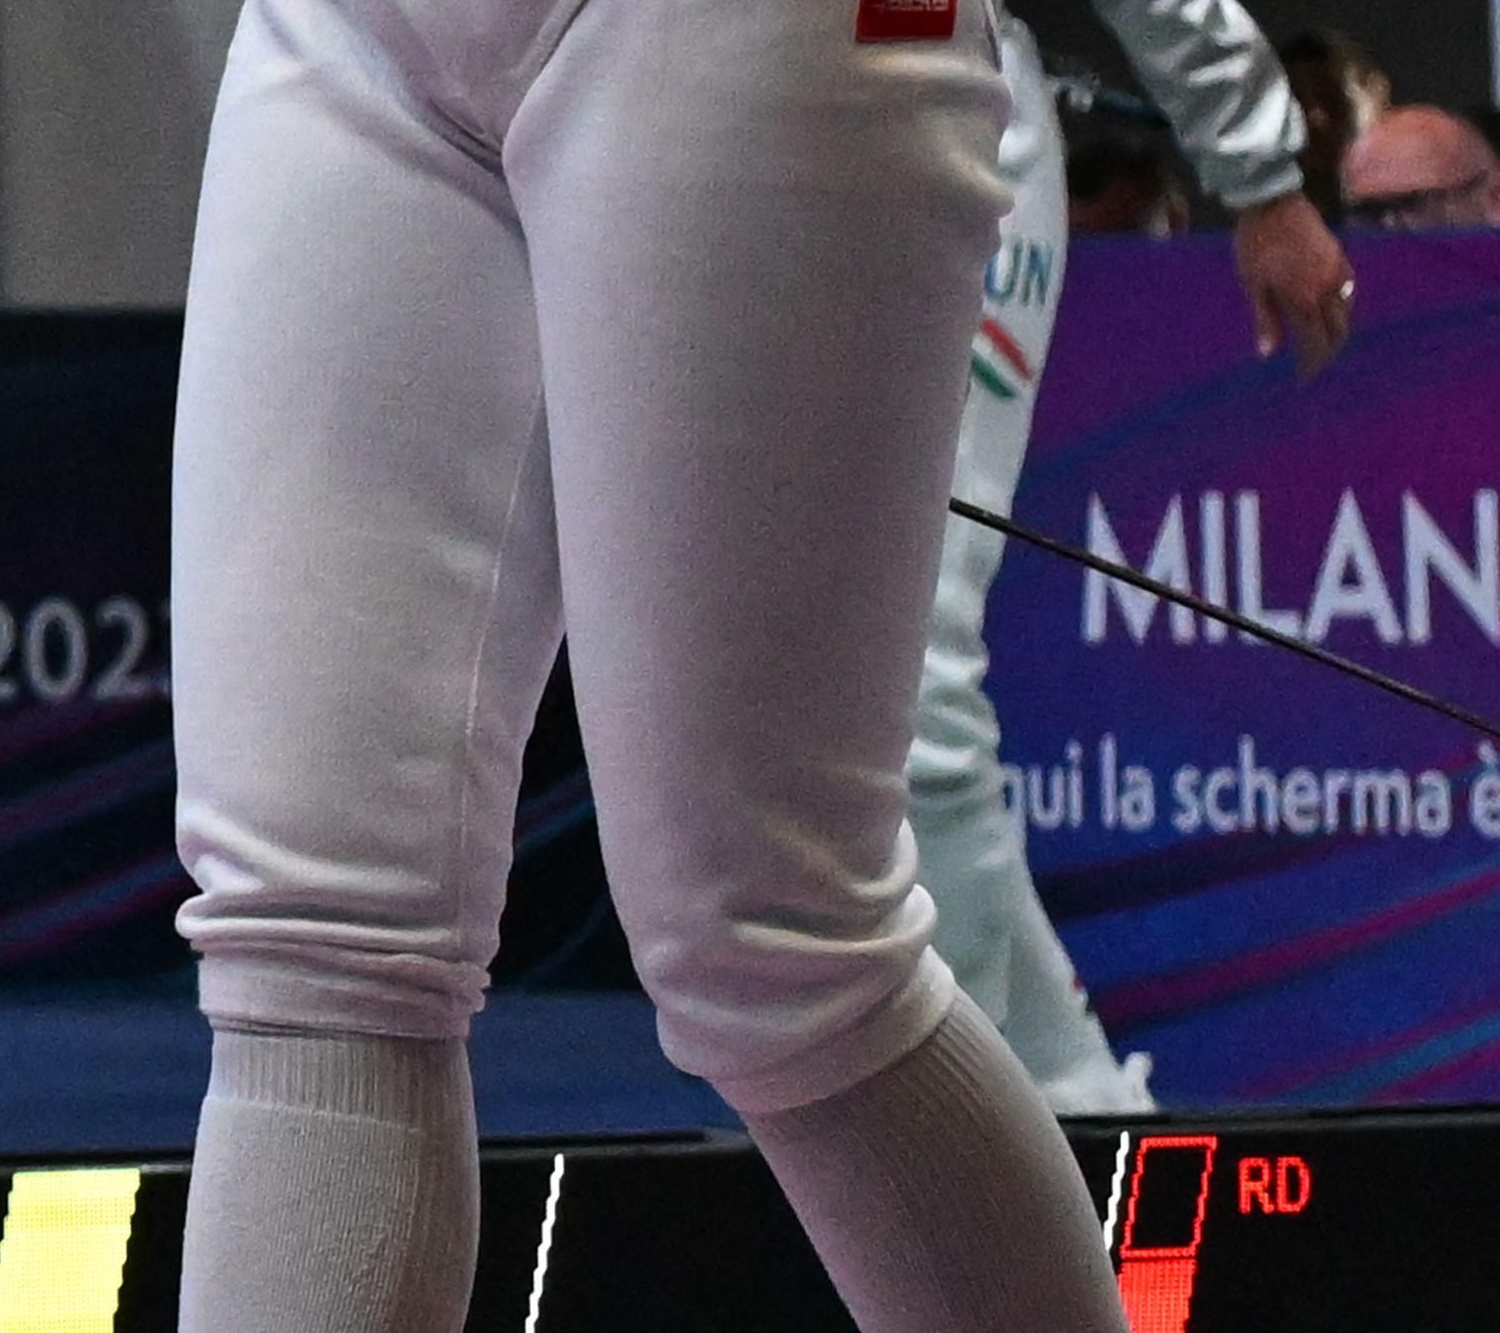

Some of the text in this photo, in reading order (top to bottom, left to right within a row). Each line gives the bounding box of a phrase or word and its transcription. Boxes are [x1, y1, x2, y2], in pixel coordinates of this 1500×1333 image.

[1080, 488, 1500, 644] MILAN
[1100, 732, 1156, 831] la
[1172, 733, 1452, 837] scherma
[1237, 1157, 1311, 1214] RD
